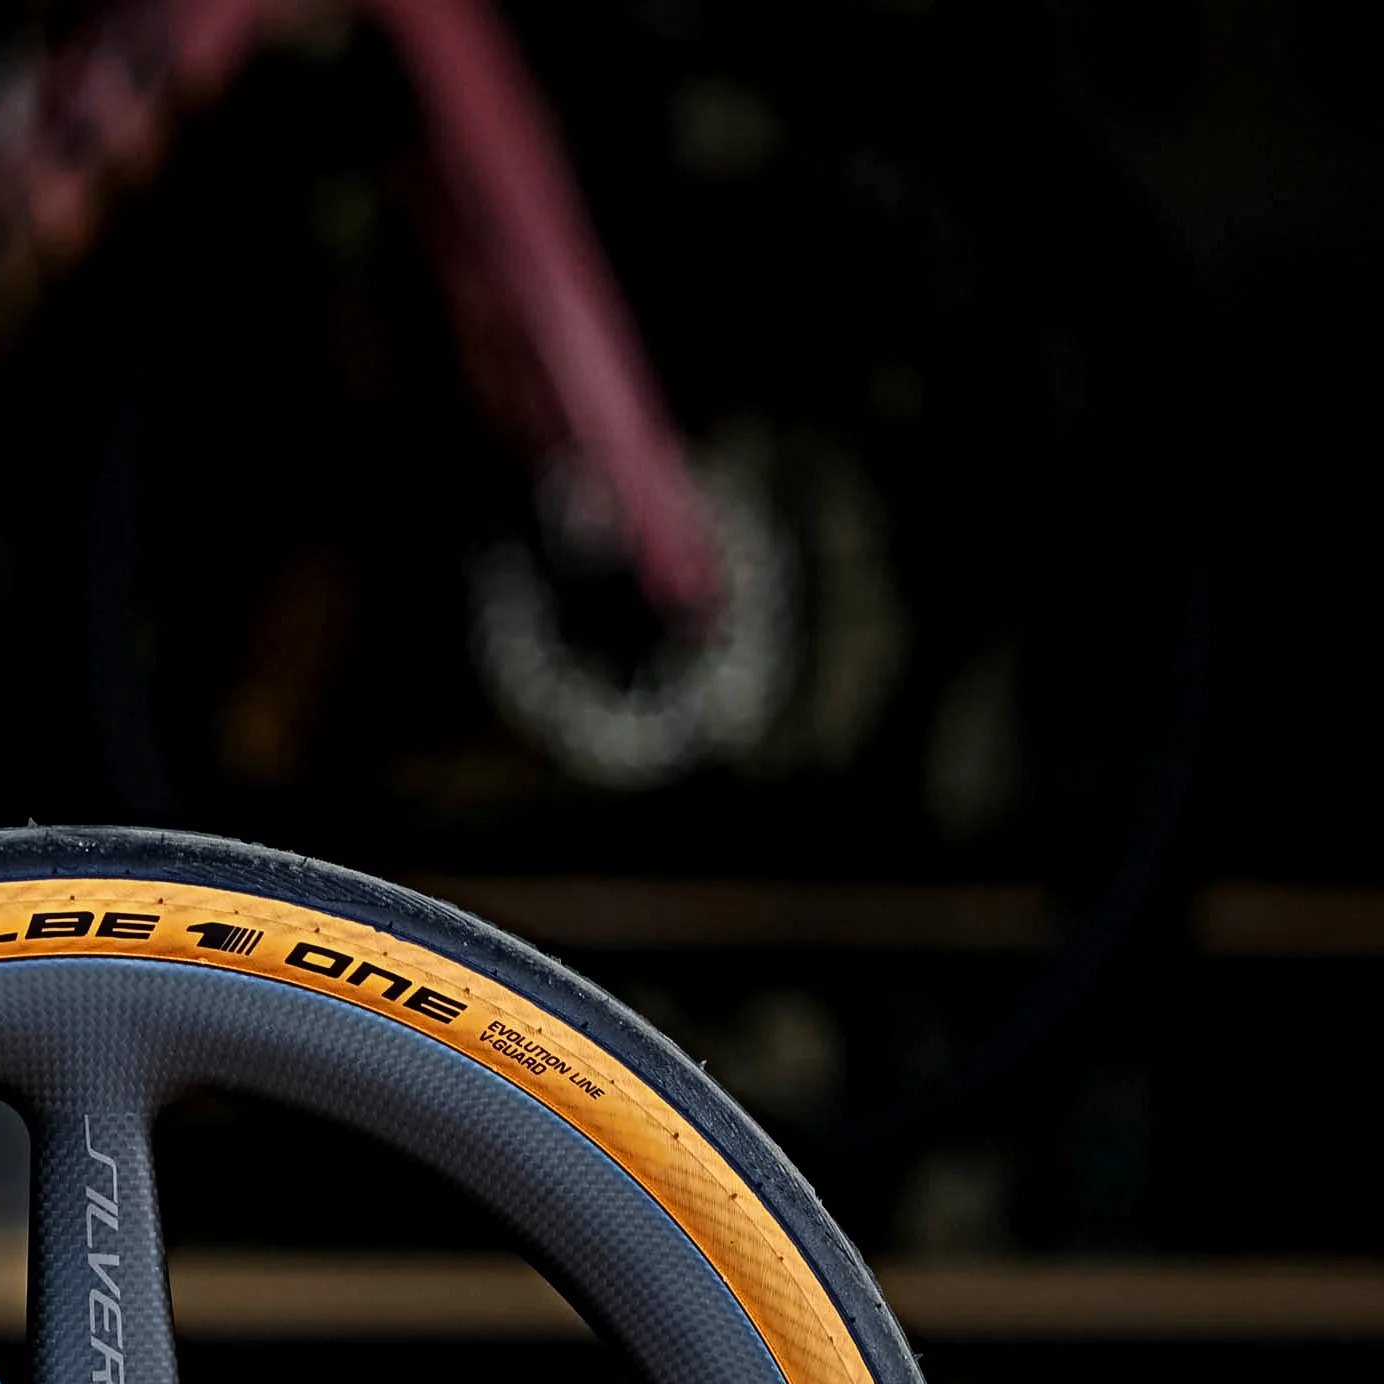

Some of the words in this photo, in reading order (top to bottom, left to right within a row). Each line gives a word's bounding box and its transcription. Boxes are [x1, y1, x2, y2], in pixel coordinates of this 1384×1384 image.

[284, 942, 467, 1025] ONE
[479, 1030, 547, 1077] V-GUARD
[488, 1020, 572, 1077] EVOLUTION
[568, 1071, 605, 1100] LINE
